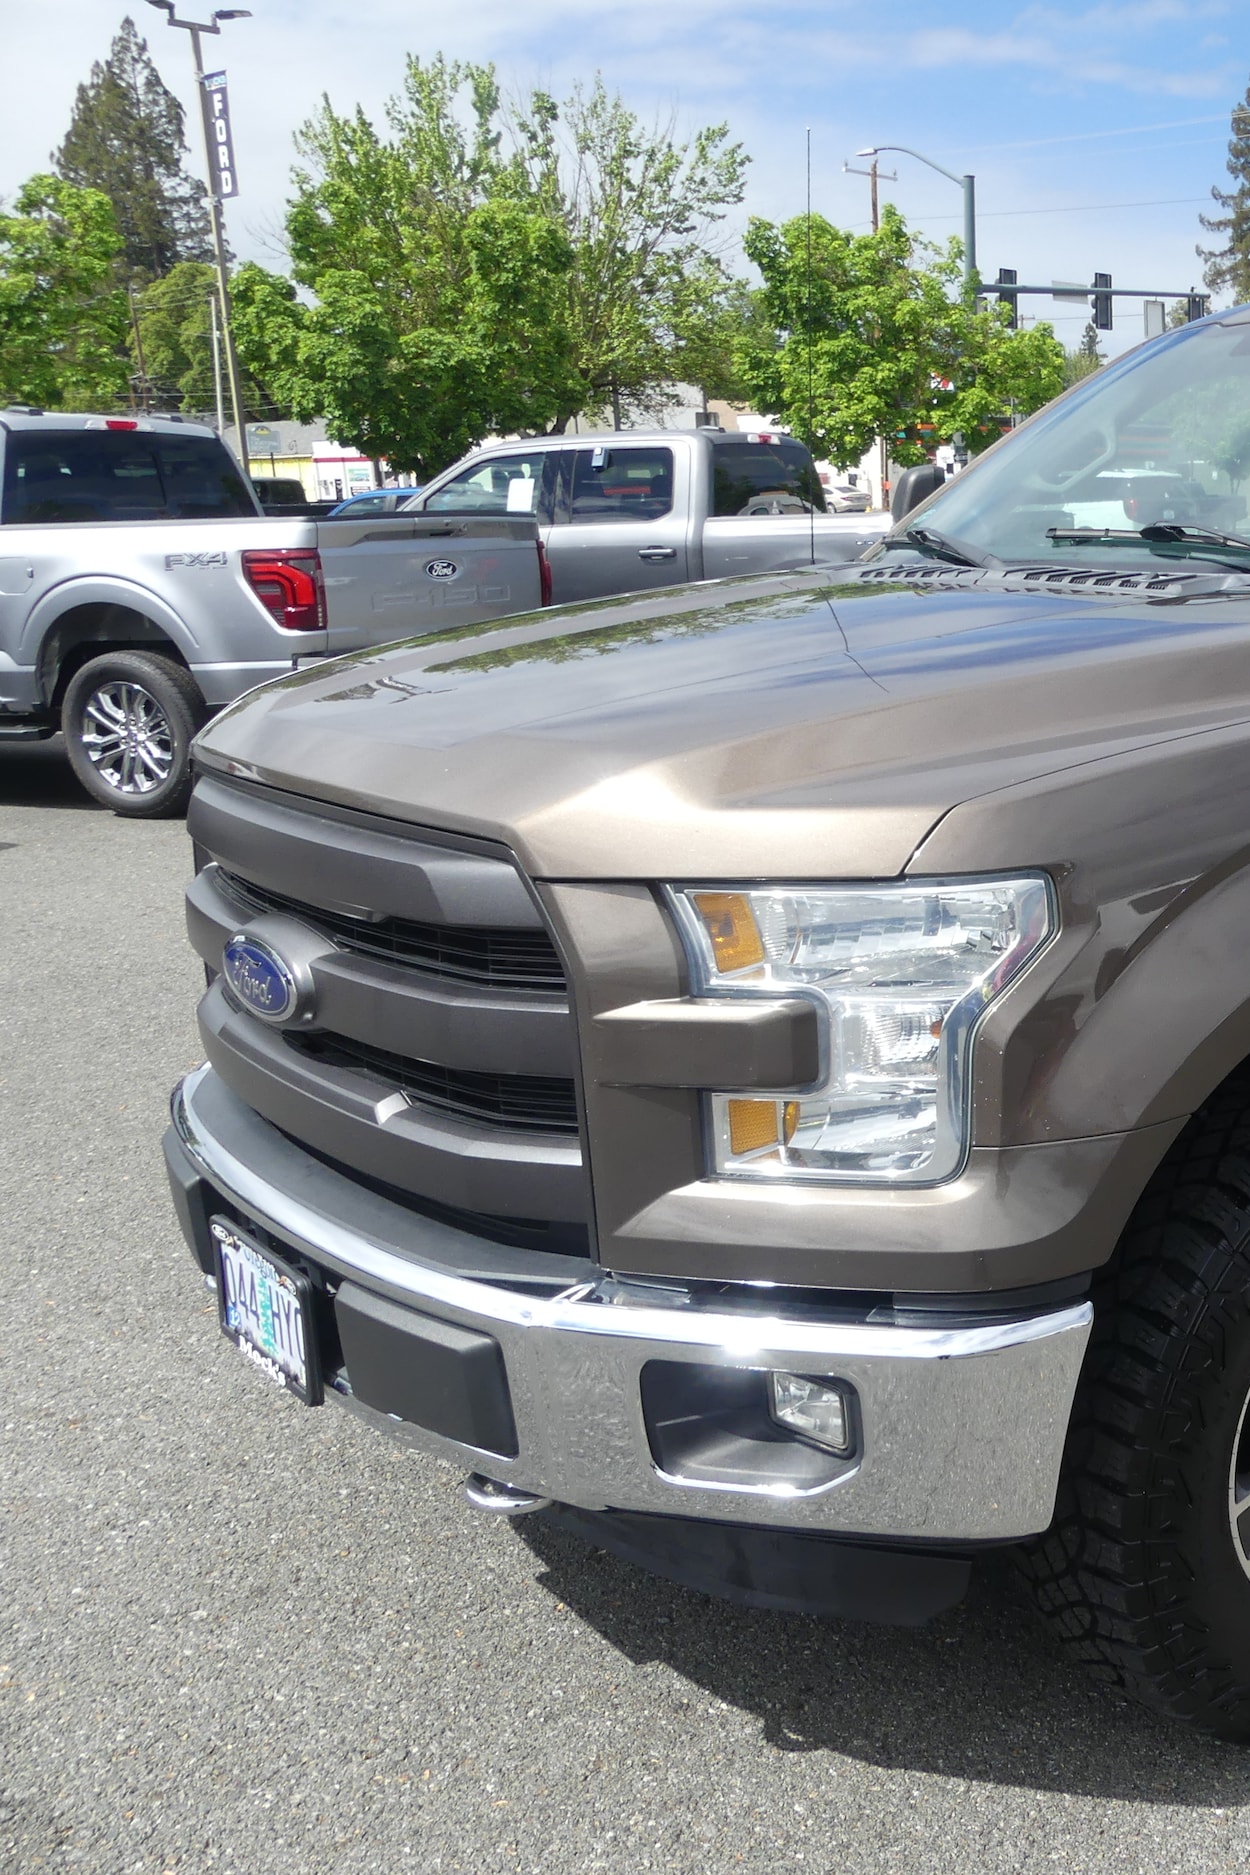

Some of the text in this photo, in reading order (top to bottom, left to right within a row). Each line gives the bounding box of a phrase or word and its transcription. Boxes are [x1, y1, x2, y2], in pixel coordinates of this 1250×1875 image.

[213, 93, 231, 194] FORD
[165, 552, 228, 571] FX4
[432, 562, 453, 576] Ford
[233, 951, 273, 1005] Ford
